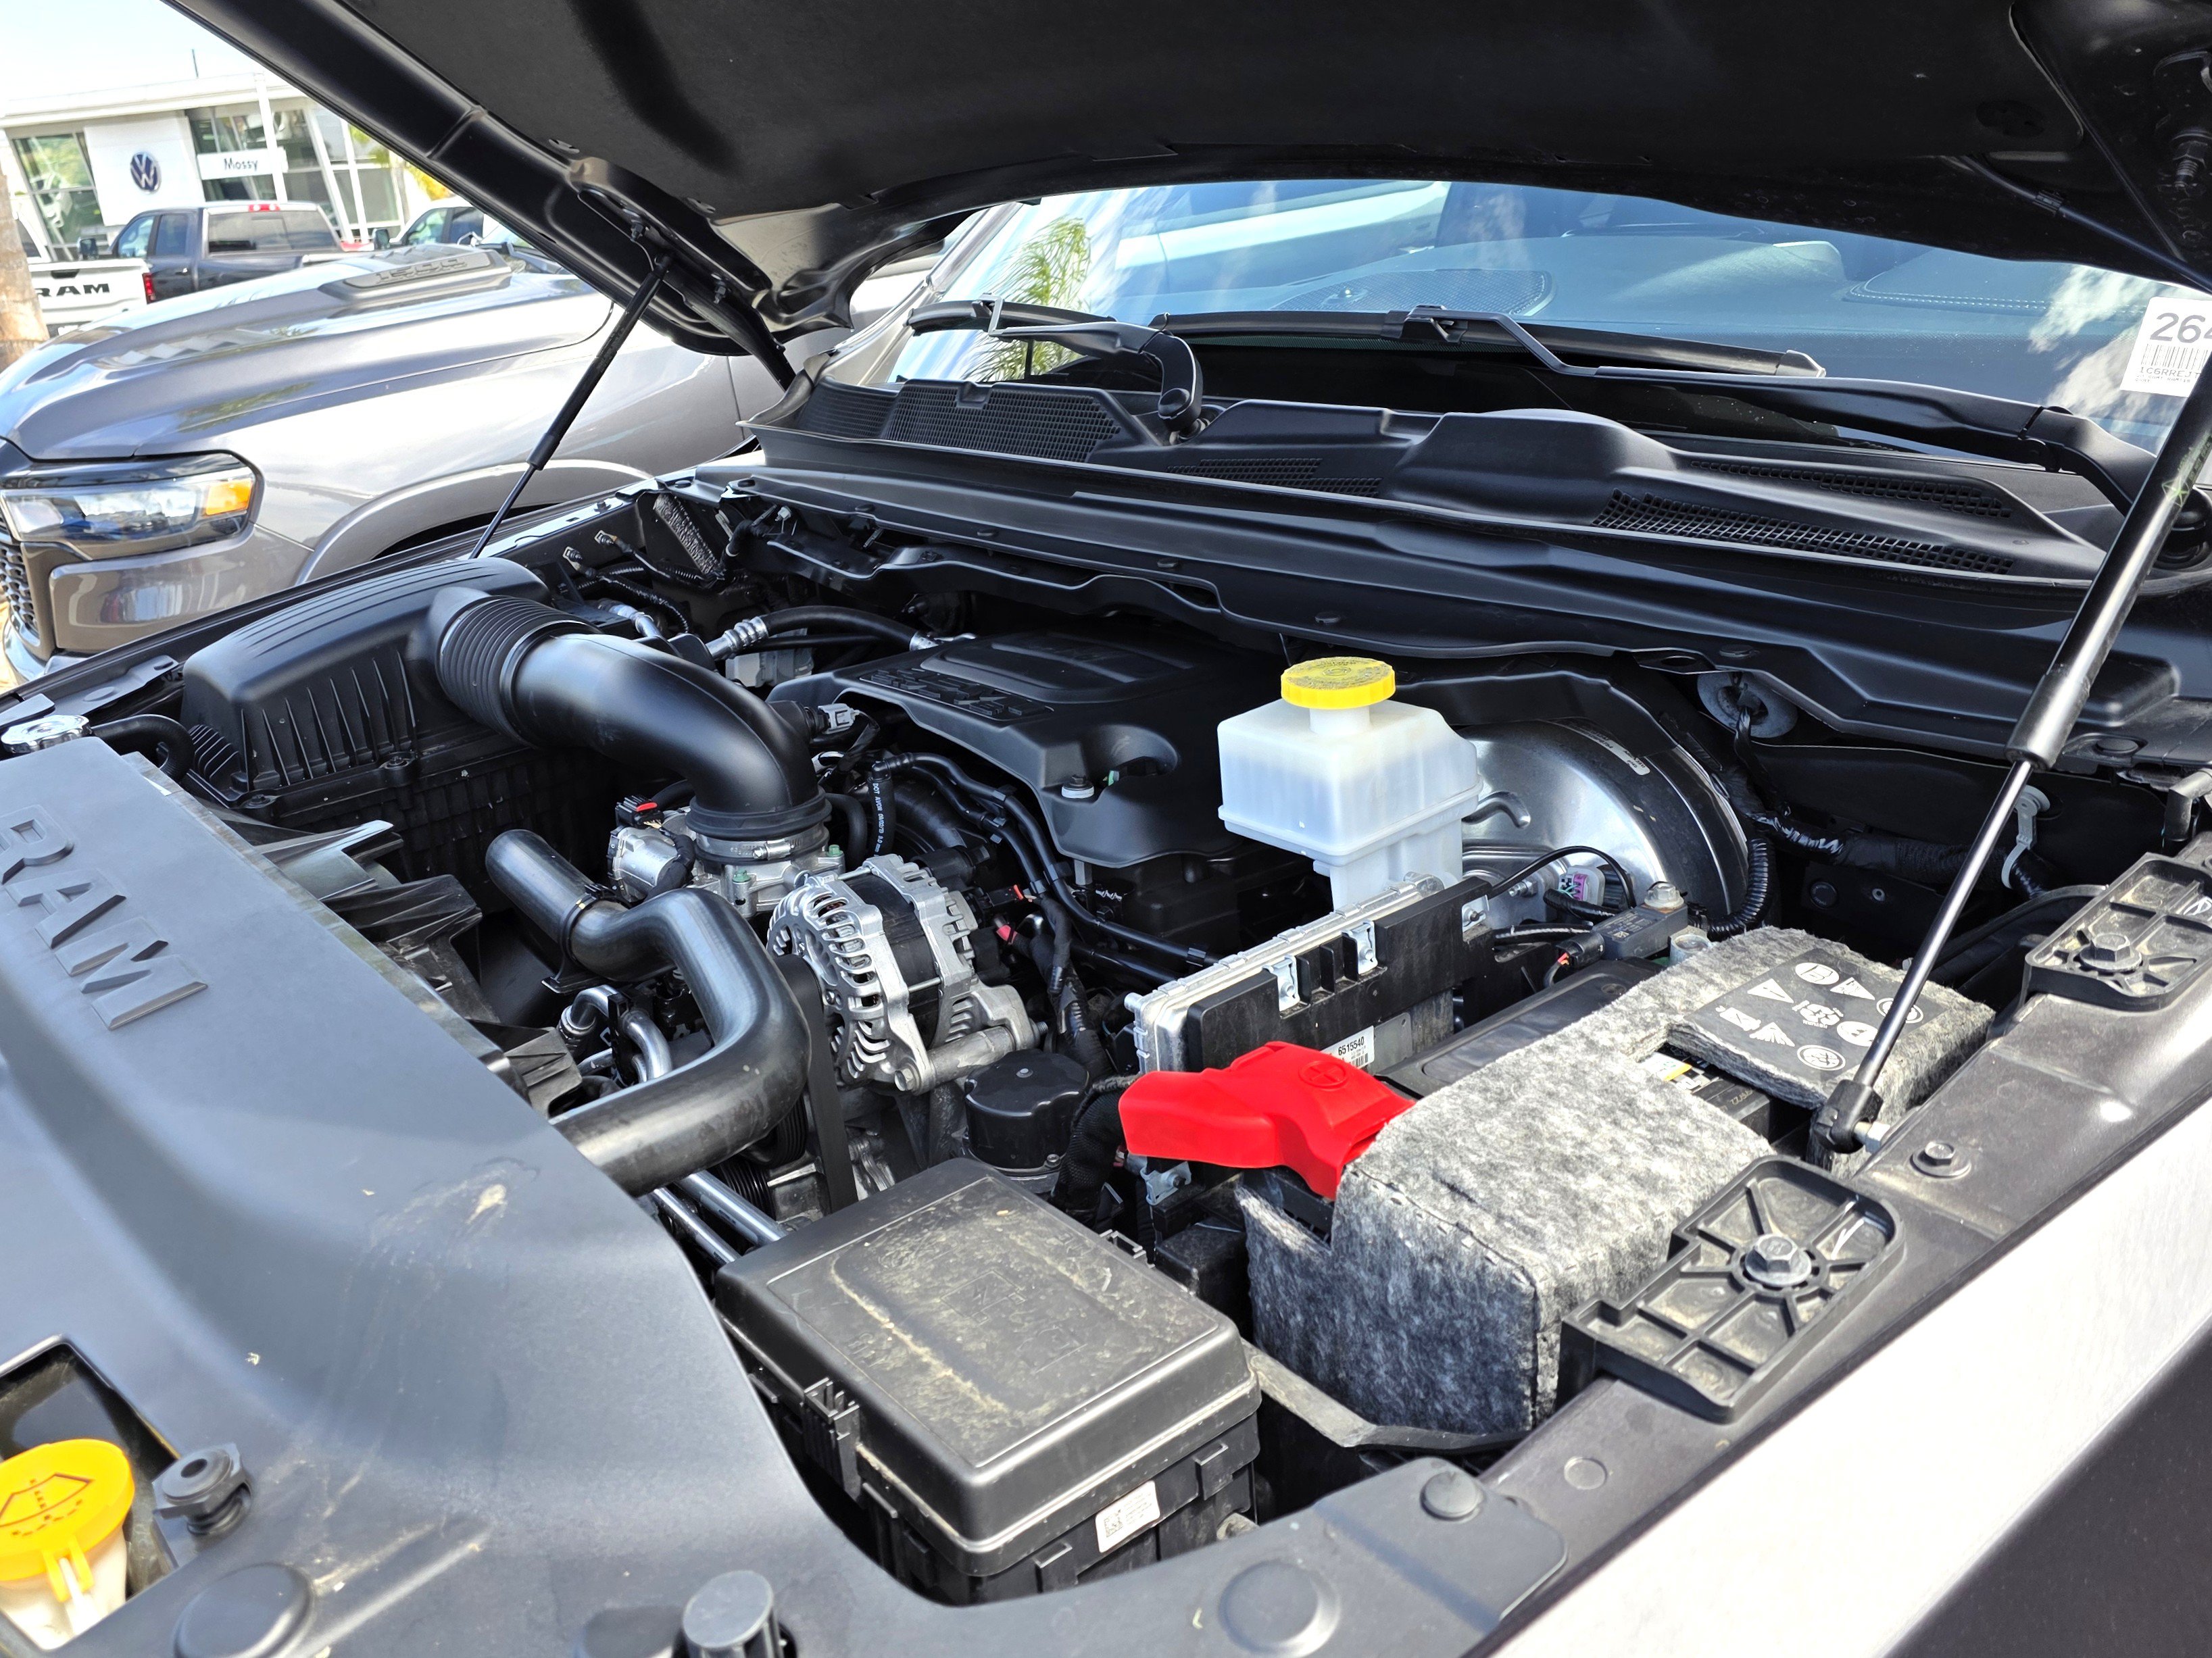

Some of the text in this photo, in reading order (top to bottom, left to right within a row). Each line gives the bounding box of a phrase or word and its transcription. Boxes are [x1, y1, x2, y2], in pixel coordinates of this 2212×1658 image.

[224, 157, 258, 172] Mossy
[0, 804, 209, 1031] RAM
[1338, 1036, 1365, 1056] 6515540
